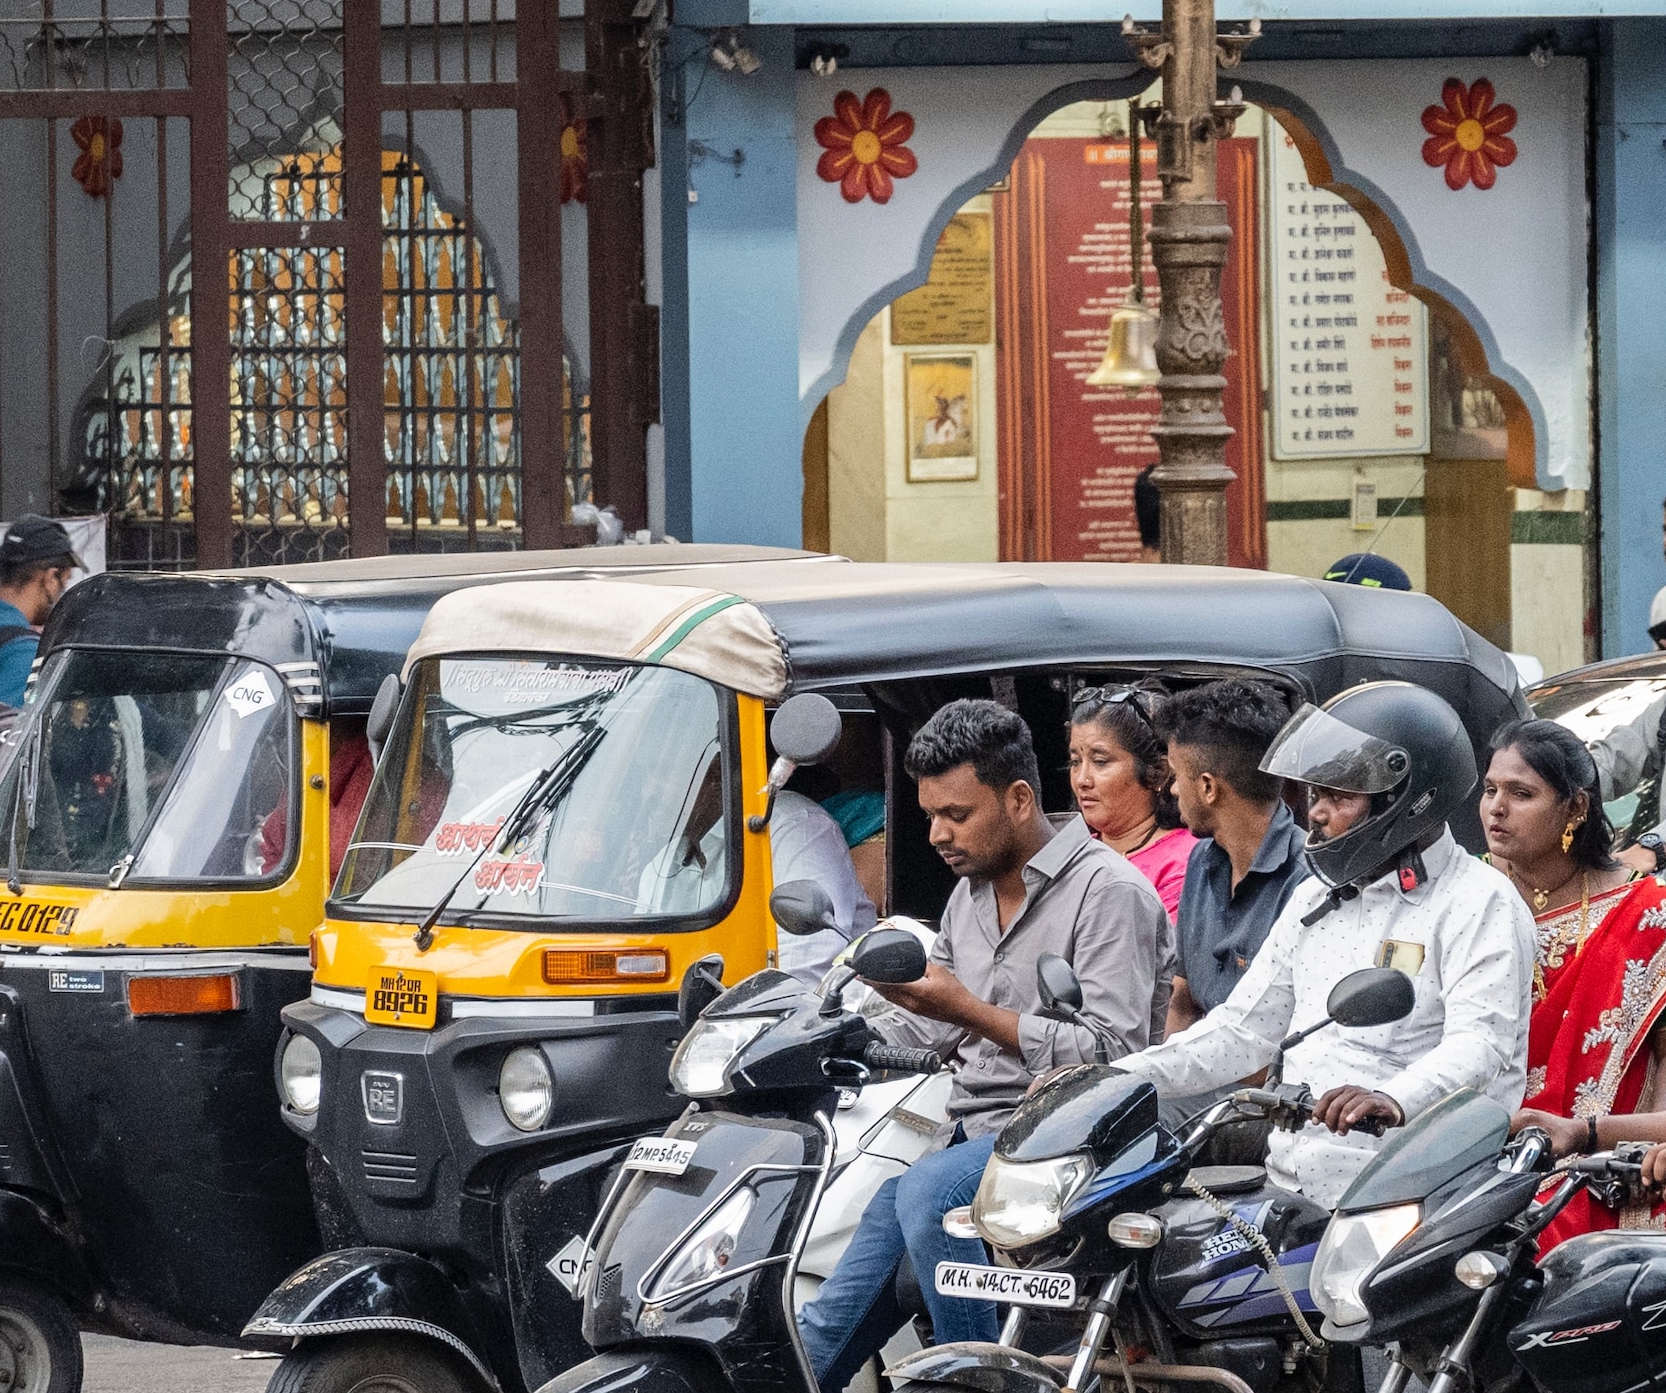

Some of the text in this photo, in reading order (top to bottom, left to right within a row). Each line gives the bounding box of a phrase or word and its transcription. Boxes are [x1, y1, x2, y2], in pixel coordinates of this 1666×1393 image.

[233, 687, 265, 704] CNG
[51, 973, 68, 989] RE
[68, 976, 87, 984] two
[373, 990, 428, 1015] 8926
[369, 1088, 396, 1112] RE
[1028, 1276, 1071, 1301] 6462
